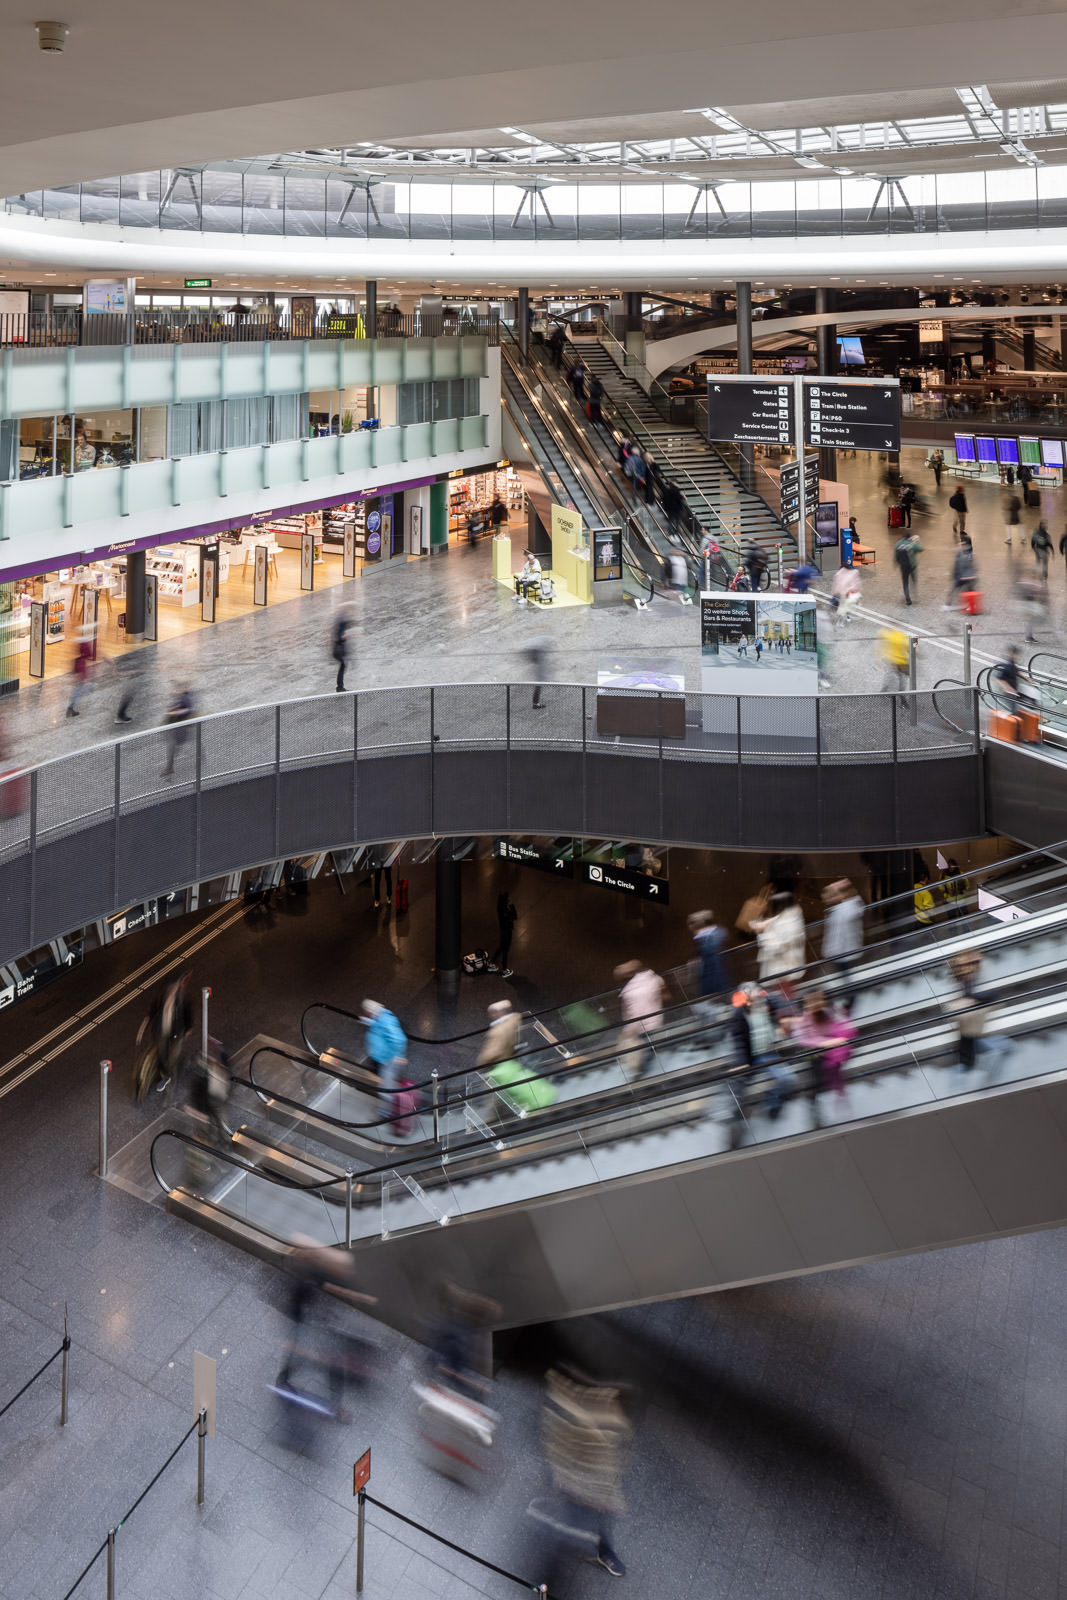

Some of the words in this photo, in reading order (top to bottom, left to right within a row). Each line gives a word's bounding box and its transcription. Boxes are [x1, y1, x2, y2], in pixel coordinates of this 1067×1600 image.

[508, 851, 522, 859] Tram
[519, 848, 540, 858] Station
[604, 876, 616, 885] The
[617, 880, 635, 890] Circle
[128, 911, 152, 928] Check-in
[18, 975, 34, 989] Bahn
[17, 984, 33, 996] Train
